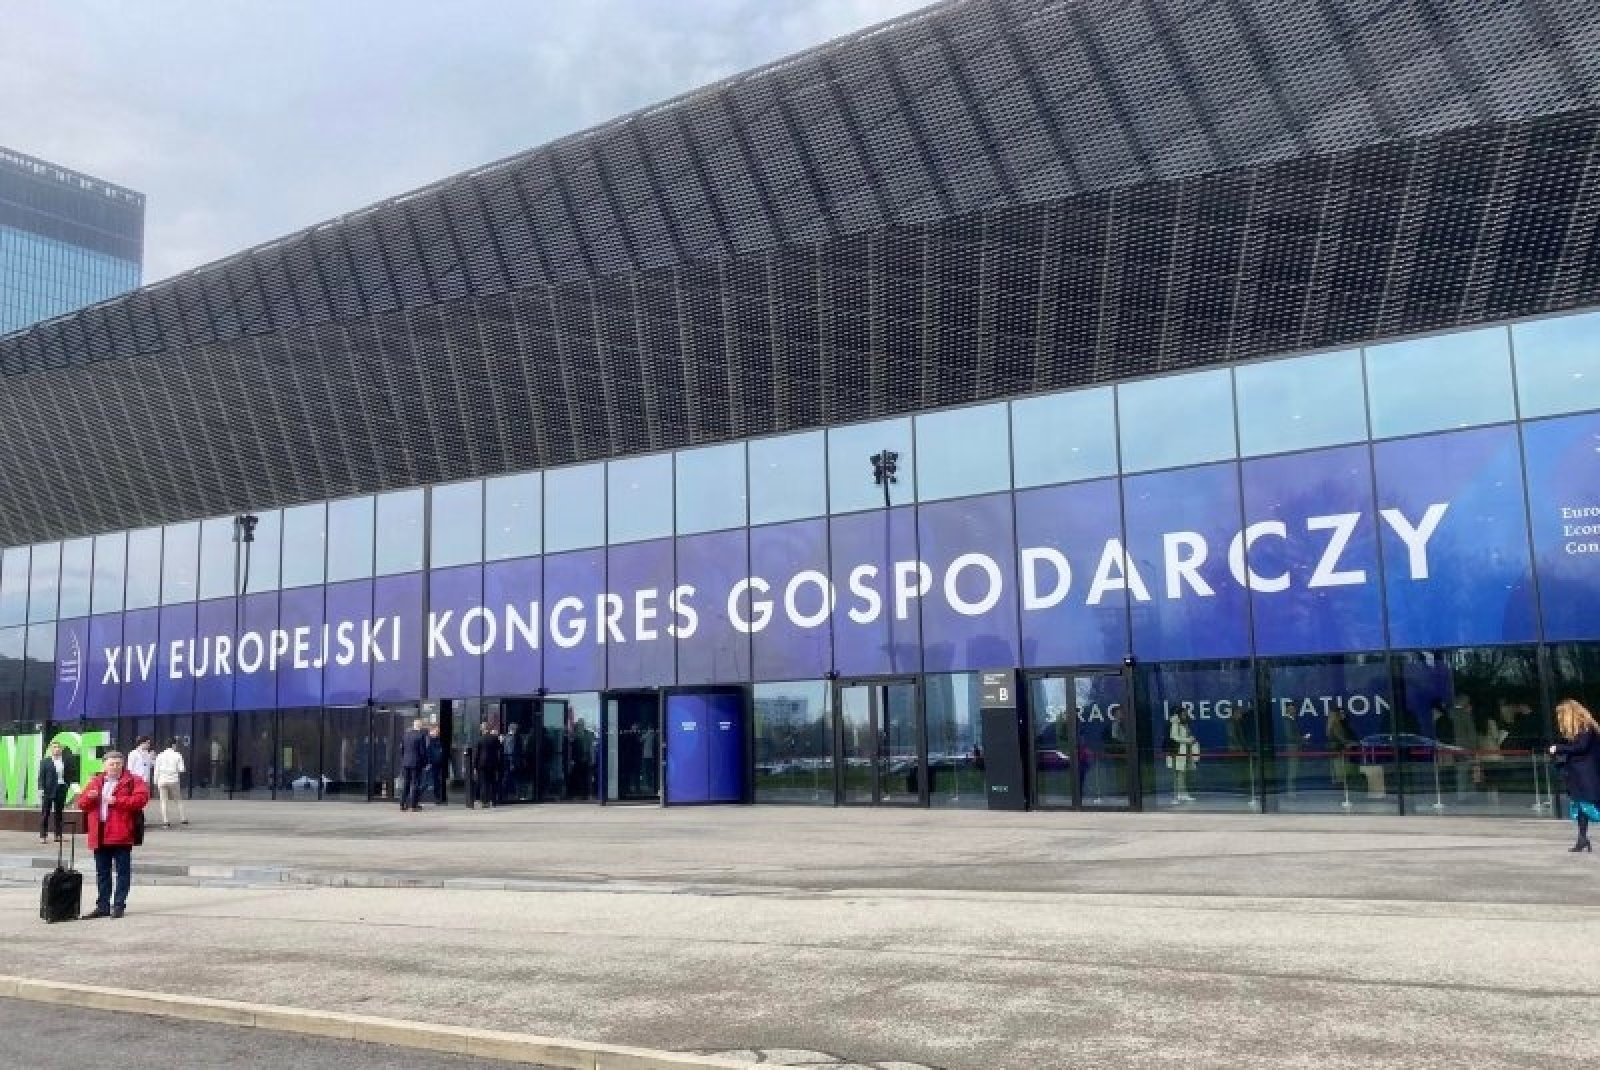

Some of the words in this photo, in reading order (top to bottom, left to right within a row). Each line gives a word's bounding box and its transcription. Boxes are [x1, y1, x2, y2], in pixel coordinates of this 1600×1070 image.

[101, 643, 156, 685] XIV
[169, 615, 401, 679] EUROPEJSKI
[427, 584, 698, 658] KONGRES
[727, 502, 1449, 634] GOSPODARCZY
